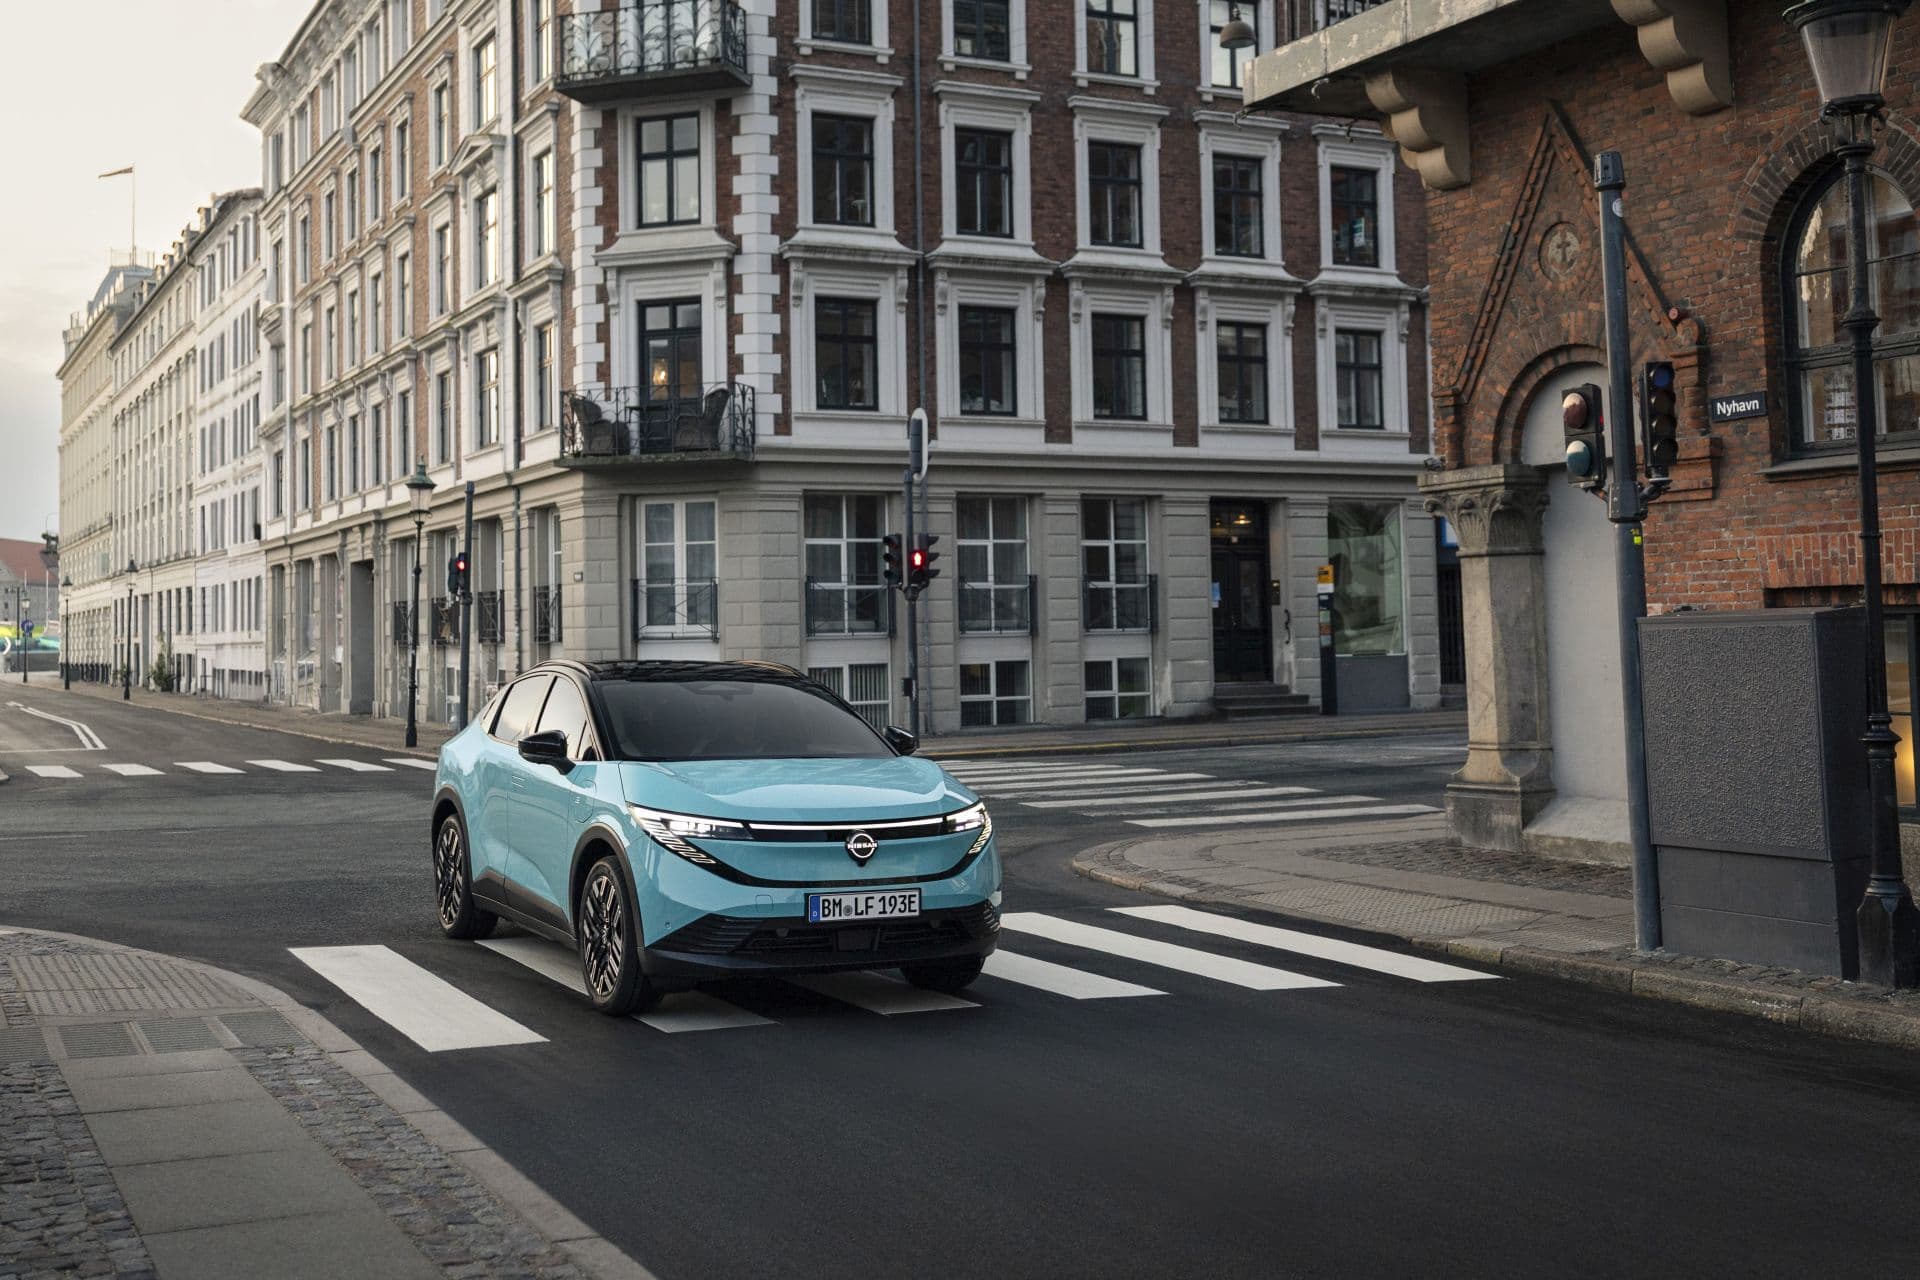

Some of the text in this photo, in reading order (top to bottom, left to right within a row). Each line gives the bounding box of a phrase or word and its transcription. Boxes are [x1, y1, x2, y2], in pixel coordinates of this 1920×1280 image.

[1716, 399, 1760, 416] Nyhavn
[821, 894, 918, 918] BM LF 193E
